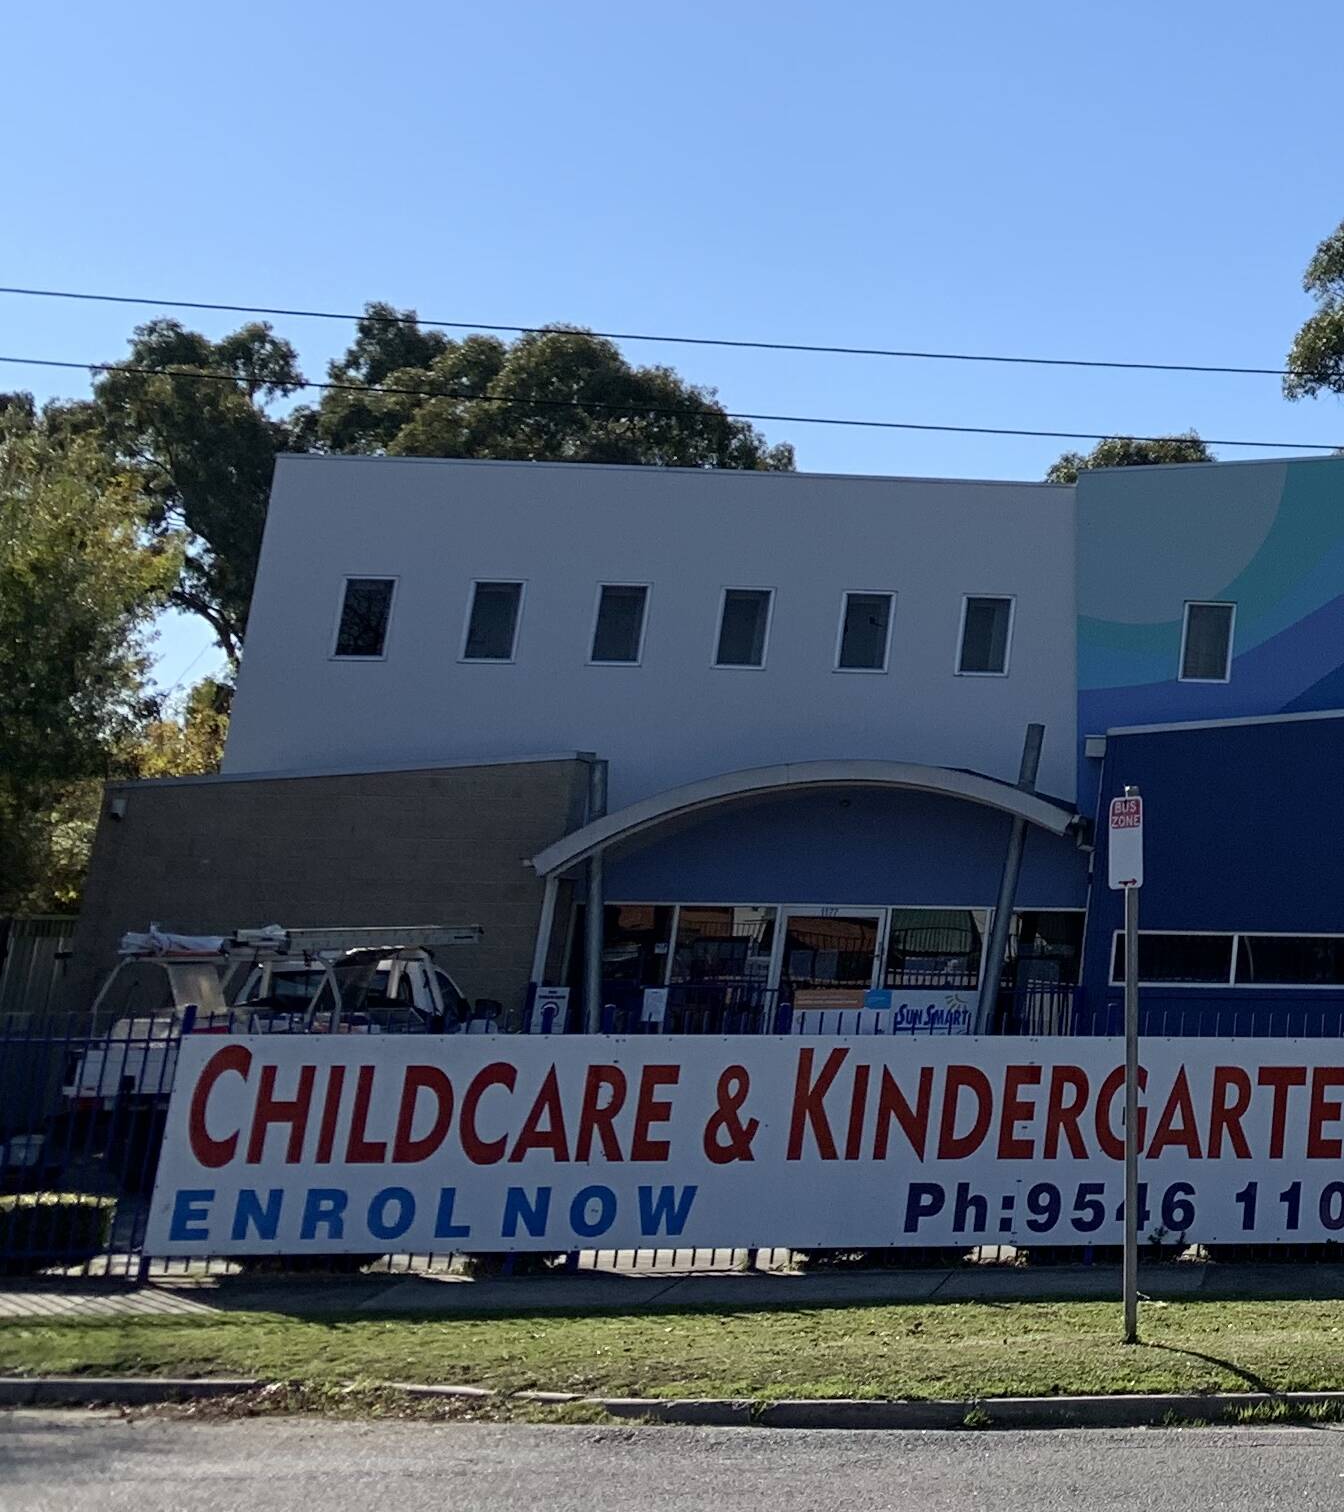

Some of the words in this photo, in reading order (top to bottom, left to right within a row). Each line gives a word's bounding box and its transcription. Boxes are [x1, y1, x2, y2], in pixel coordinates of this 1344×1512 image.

[1111, 815, 1140, 827] ZONE
[1114, 801, 1136, 813] BUS
[187, 1043, 682, 1168] CHILDCARE
[703, 1064, 760, 1165] &
[168, 1185, 471, 1241] ENROL
[500, 1184, 699, 1239] NOW
